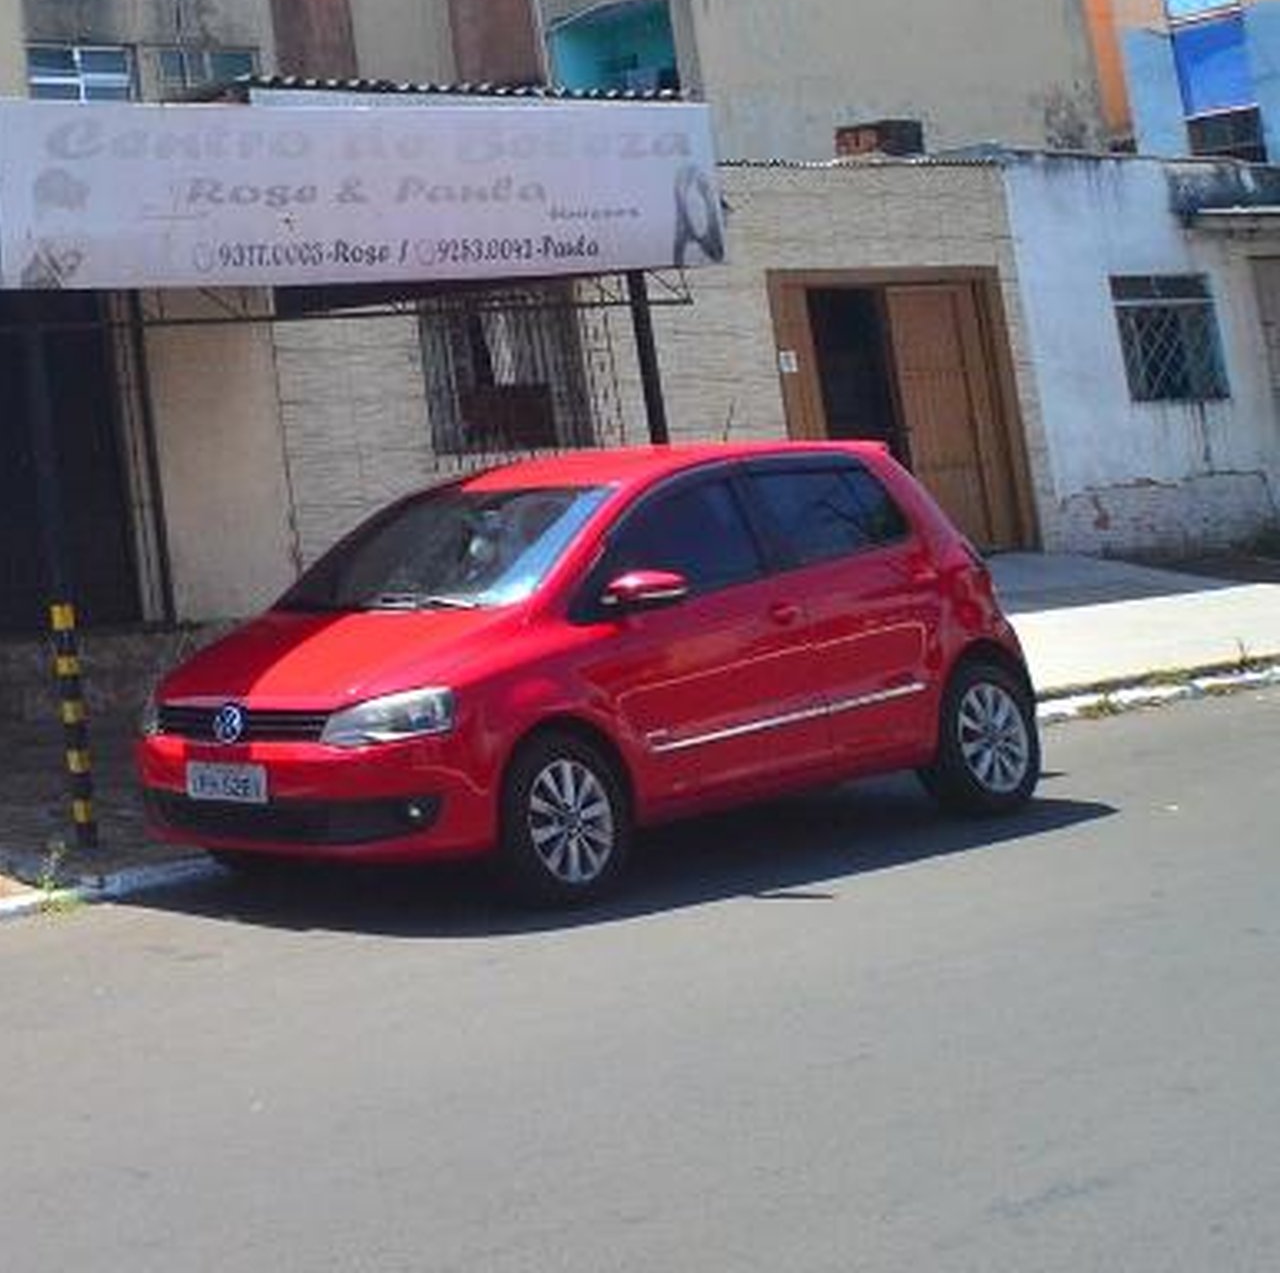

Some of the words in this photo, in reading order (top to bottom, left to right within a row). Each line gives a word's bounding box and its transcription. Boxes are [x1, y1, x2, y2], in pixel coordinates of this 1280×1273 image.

[190, 178, 319, 208] Rose
[335, 177, 368, 205] &
[395, 175, 547, 205] Paula
